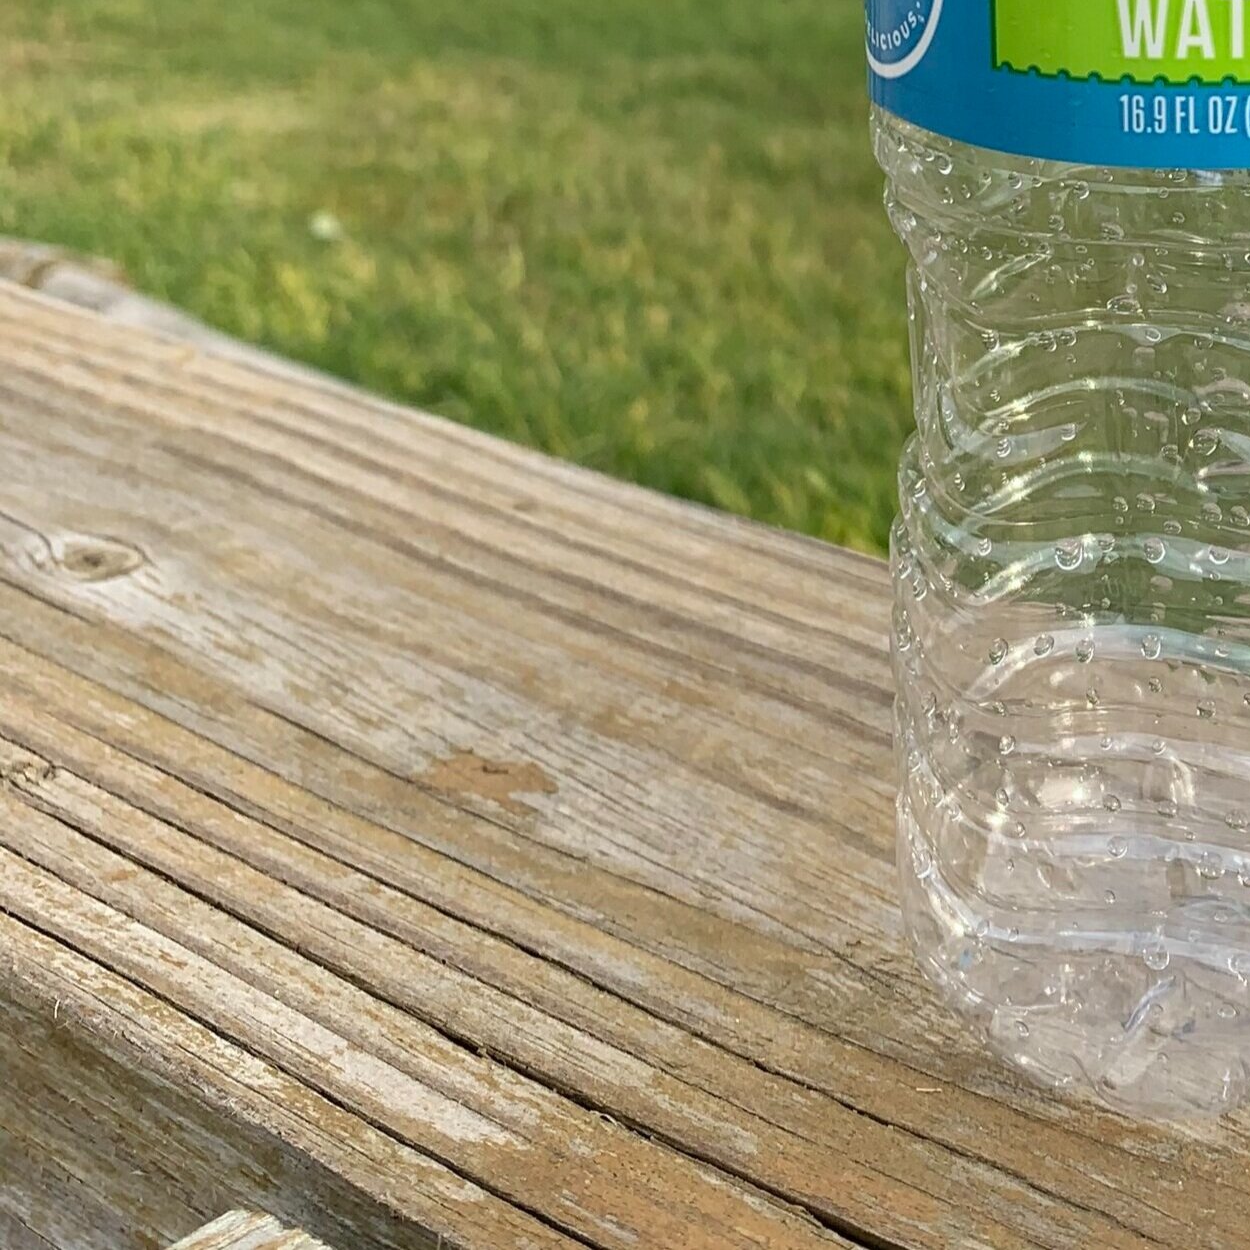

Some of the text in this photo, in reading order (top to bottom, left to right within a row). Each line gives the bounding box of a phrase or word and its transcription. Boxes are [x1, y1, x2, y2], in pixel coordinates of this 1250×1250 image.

[1119, 94, 1168, 135] 16.9
[1174, 95, 1201, 135] FL
[1207, 94, 1239, 135] OZ
